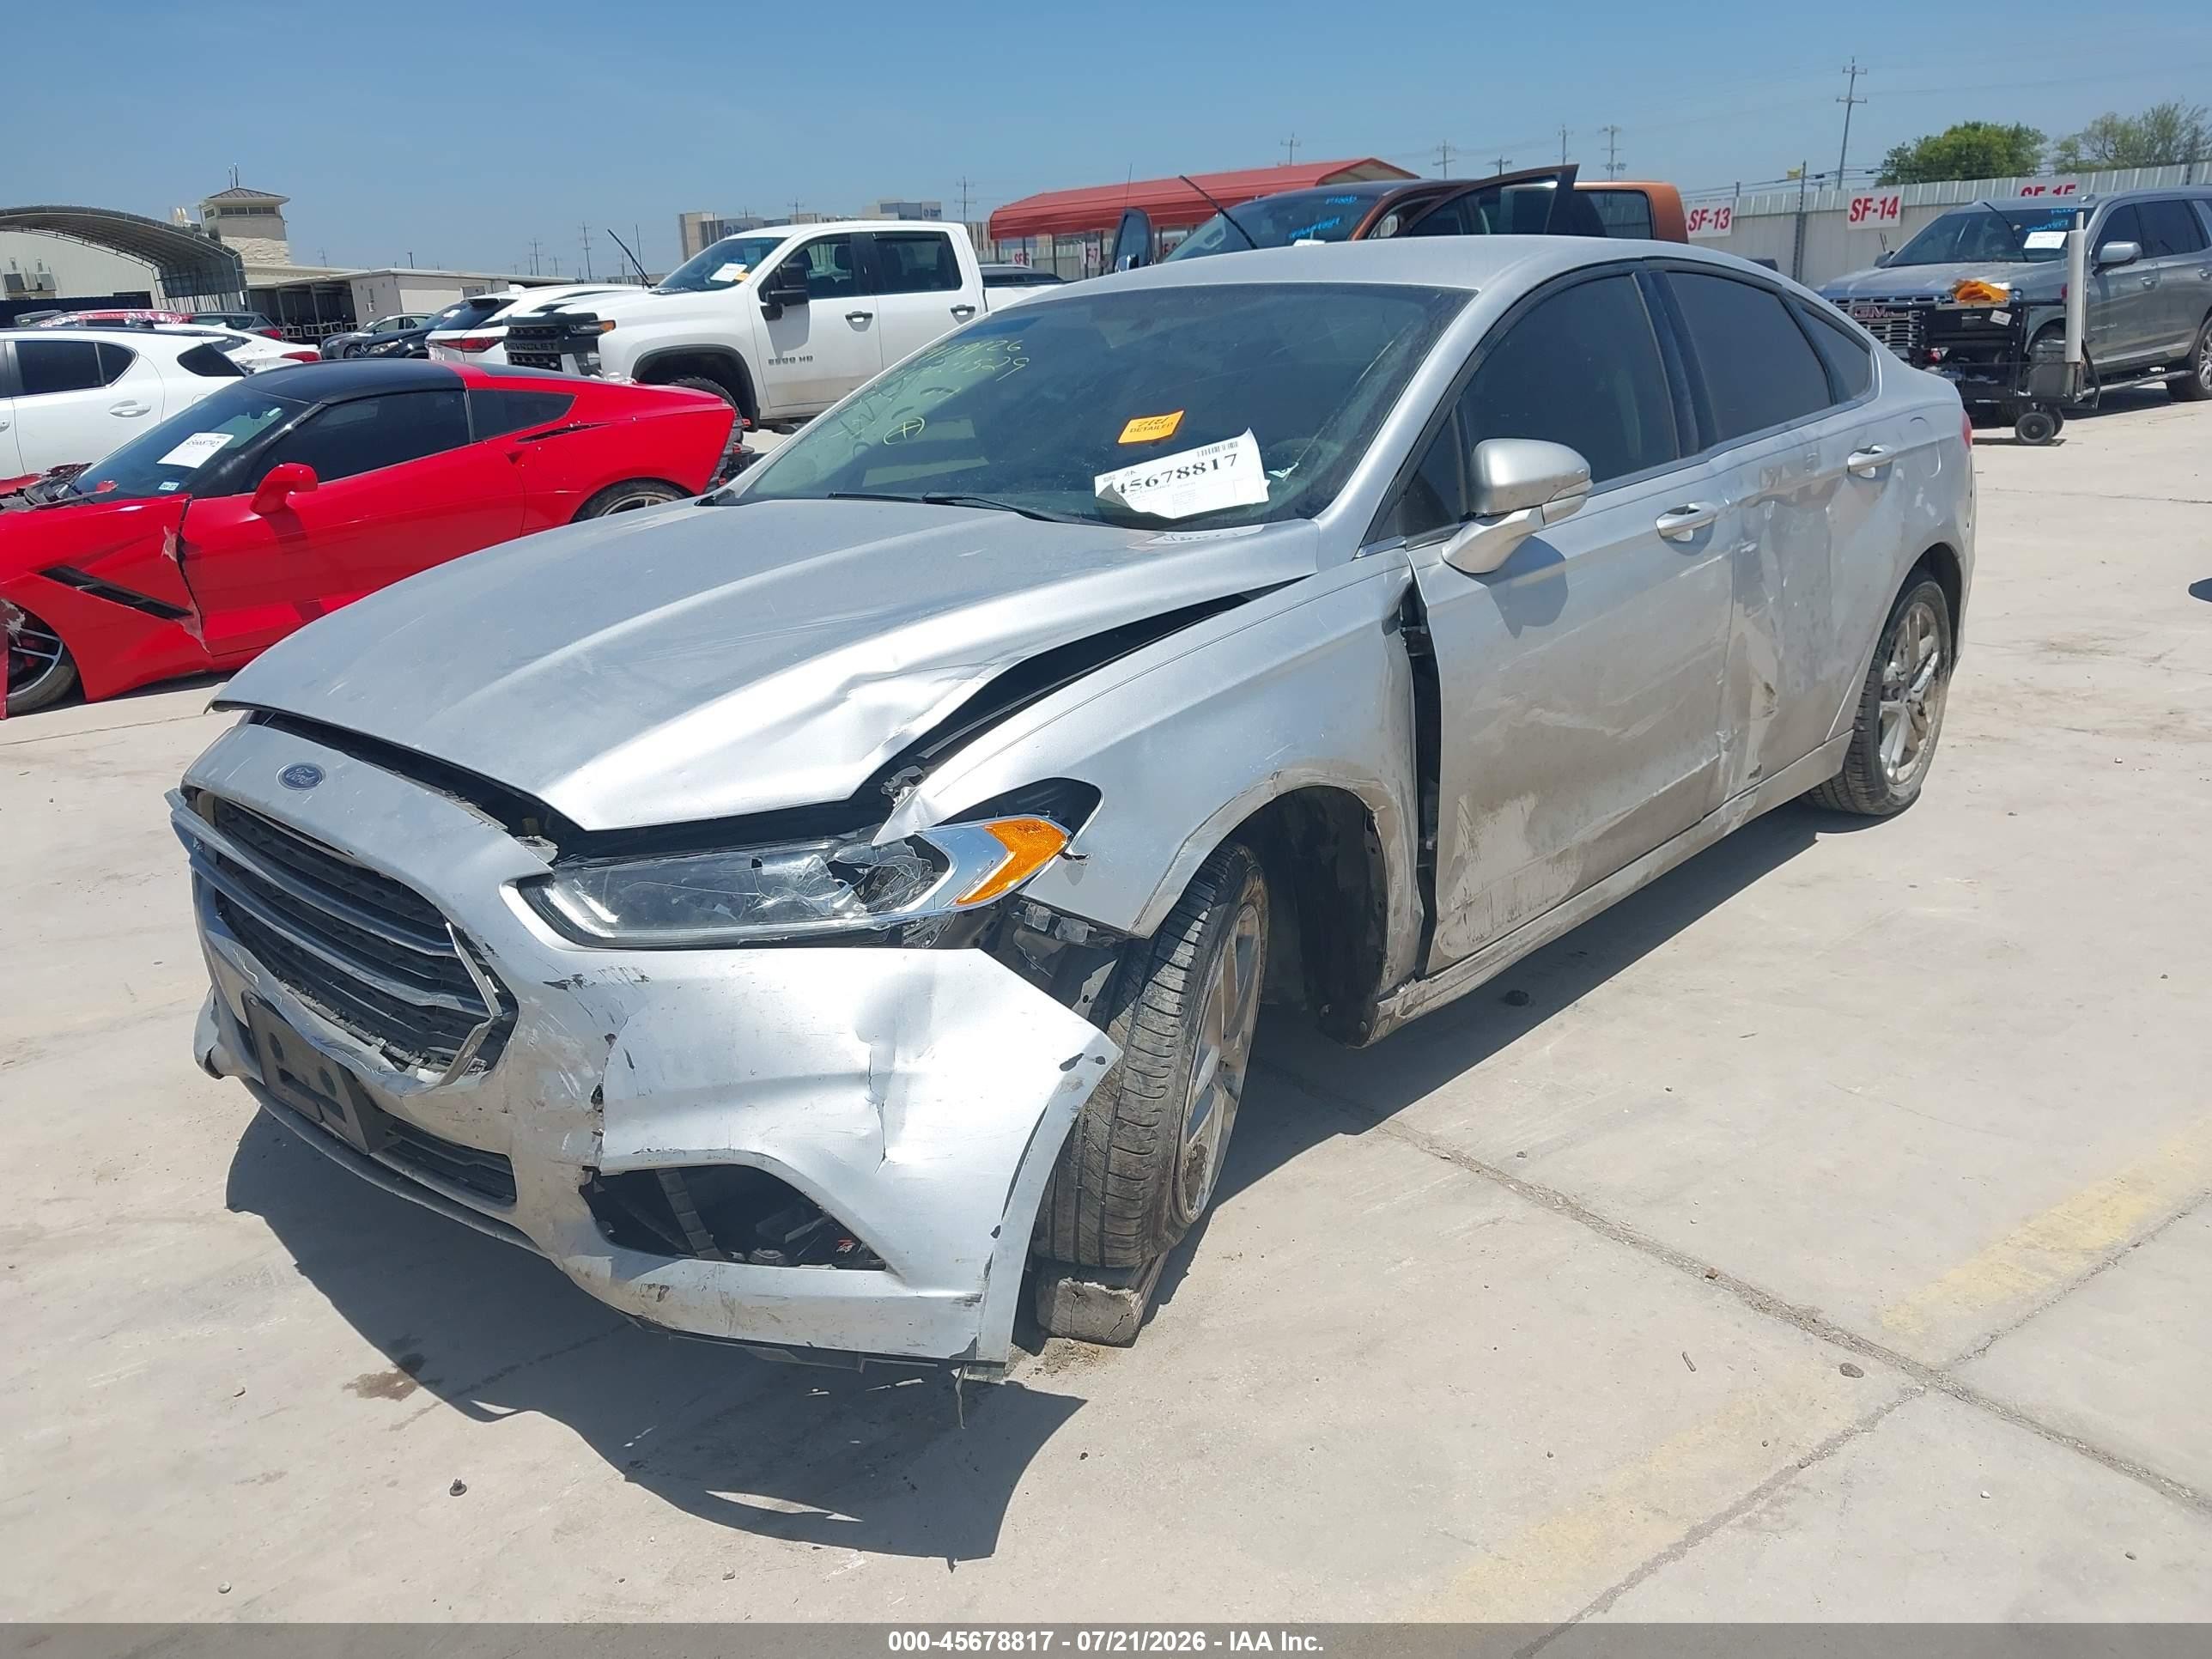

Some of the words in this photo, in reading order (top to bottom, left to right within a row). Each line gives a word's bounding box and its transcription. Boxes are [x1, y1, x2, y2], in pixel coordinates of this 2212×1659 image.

[1688, 207, 1730, 231] SF-13
[1849, 196, 1899, 222] SF-14
[1854, 306, 1906, 319] GMC
[1116, 453, 1238, 495] 45678817
[285, 767, 317, 785] Ford
